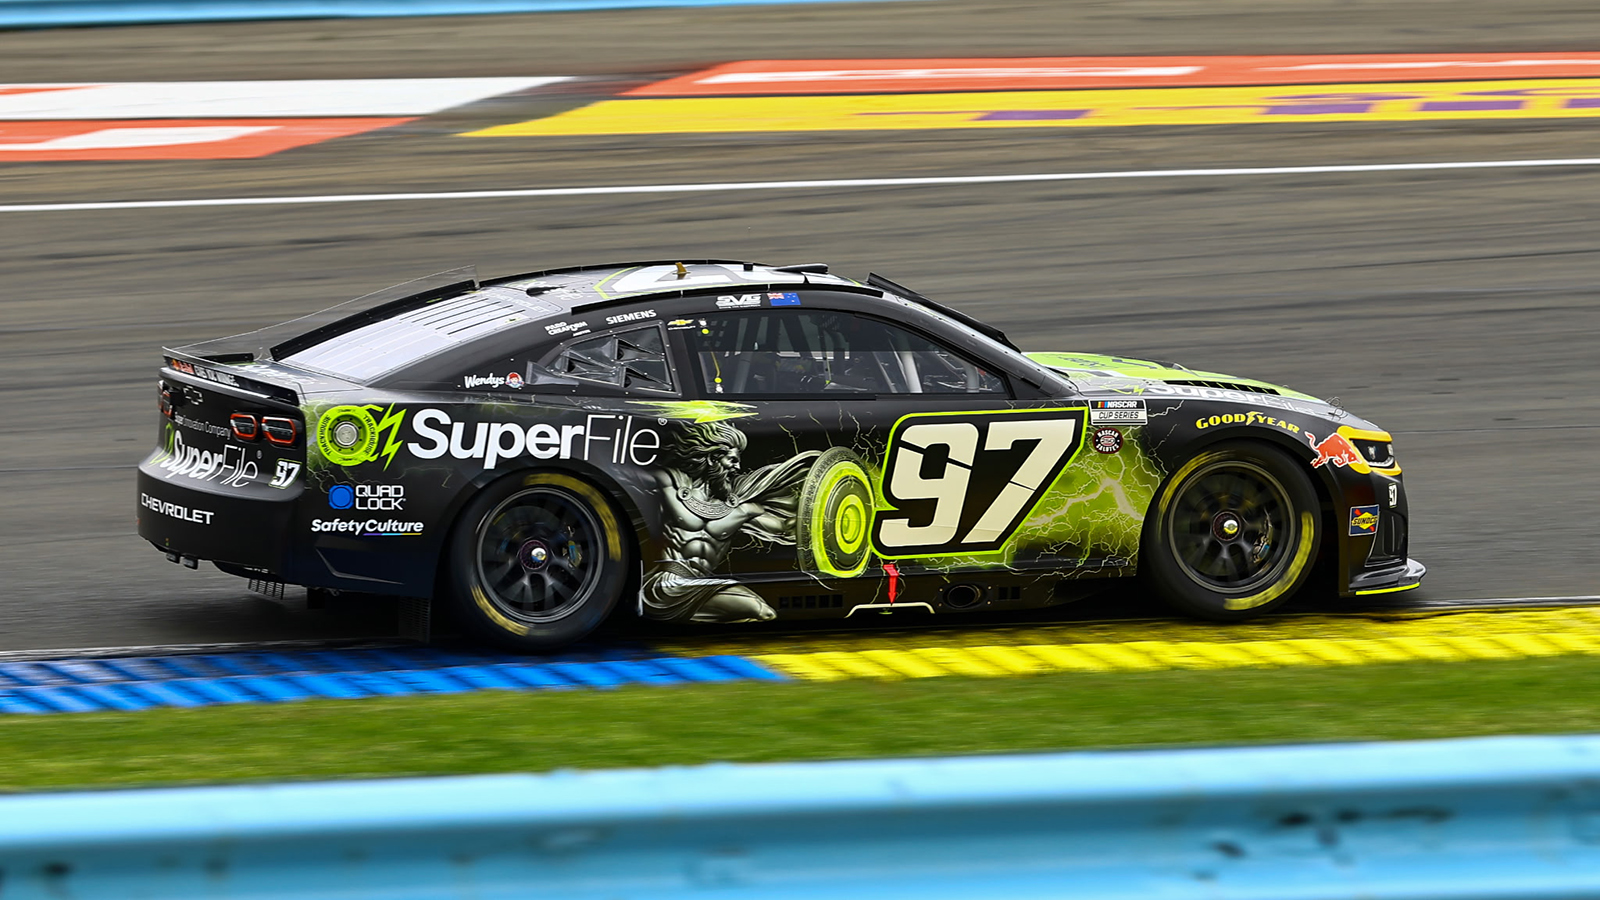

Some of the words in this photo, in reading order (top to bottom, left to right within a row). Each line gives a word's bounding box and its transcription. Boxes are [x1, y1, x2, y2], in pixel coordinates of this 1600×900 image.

[715, 294, 761, 307] SVG
[605, 310, 657, 324] SIEMENS
[464, 373, 505, 388] Wendys
[1099, 411, 1113, 419] CUP
[1114, 411, 1139, 419] SERIES
[1195, 411, 1300, 433] GOODYEAR
[205, 421, 231, 440] Company
[319, 415, 332, 457] TRACKHOUSE
[362, 414, 377, 455] TRACKHOUSE
[408, 408, 660, 470] SuperFile
[160, 430, 258, 488] SuperFile
[270, 461, 300, 487] 97
[879, 419, 1076, 547] 97
[355, 485, 404, 498] QUAD
[141, 492, 215, 525] CHEVROLET
[355, 498, 403, 511] LOCK
[311, 518, 424, 534] SafetyCulture
